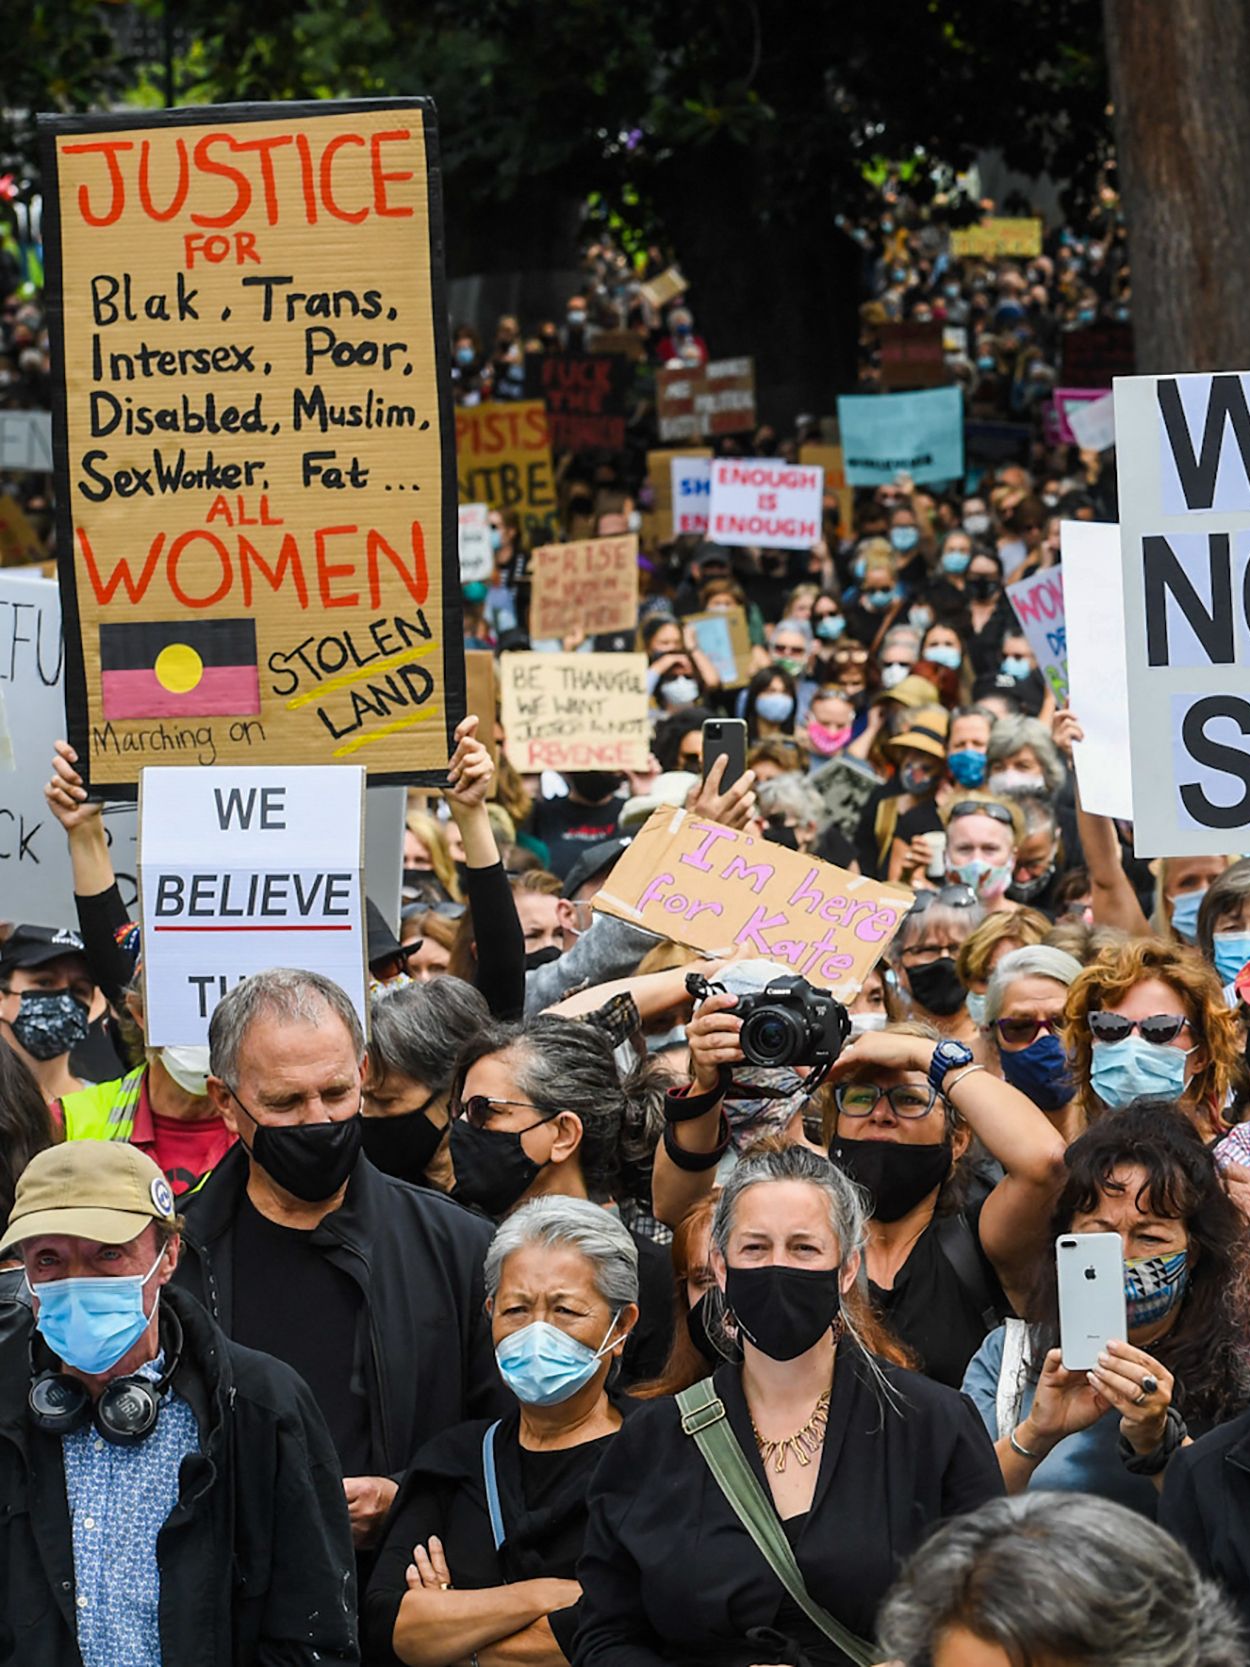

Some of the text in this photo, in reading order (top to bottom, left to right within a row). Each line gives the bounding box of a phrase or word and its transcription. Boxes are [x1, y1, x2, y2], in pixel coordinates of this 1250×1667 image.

[62, 130, 414, 228] JUSTICE
[184, 232, 261, 269] FOR
[242, 276, 398, 321] Trans,
[93, 327, 413, 381] Intersex, Poor,
[90, 385, 430, 437] Disabled, Muslim,
[302, 450, 369, 488] Fat
[718, 466, 816, 490] ENOUGH
[206, 495, 283, 527] ALL
[757, 492, 778, 511] IS
[715, 514, 816, 538] ENOUGH
[76, 520, 429, 610] WOMEN
[562, 541, 630, 575] RISE
[268, 609, 432, 696] STOLEN
[512, 665, 545, 690] BE
[317, 663, 434, 740] LAND
[516, 695, 609, 716] WE WANT
[94, 720, 266, 766] Marching on
[526, 739, 634, 769] REVENGE
[214, 787, 287, 830] WE
[154, 873, 353, 917] BELIEVE
[681, 822, 898, 942] I'm here
[636, 873, 855, 981] for Kate
[115, 1392, 140, 1421] JBL
